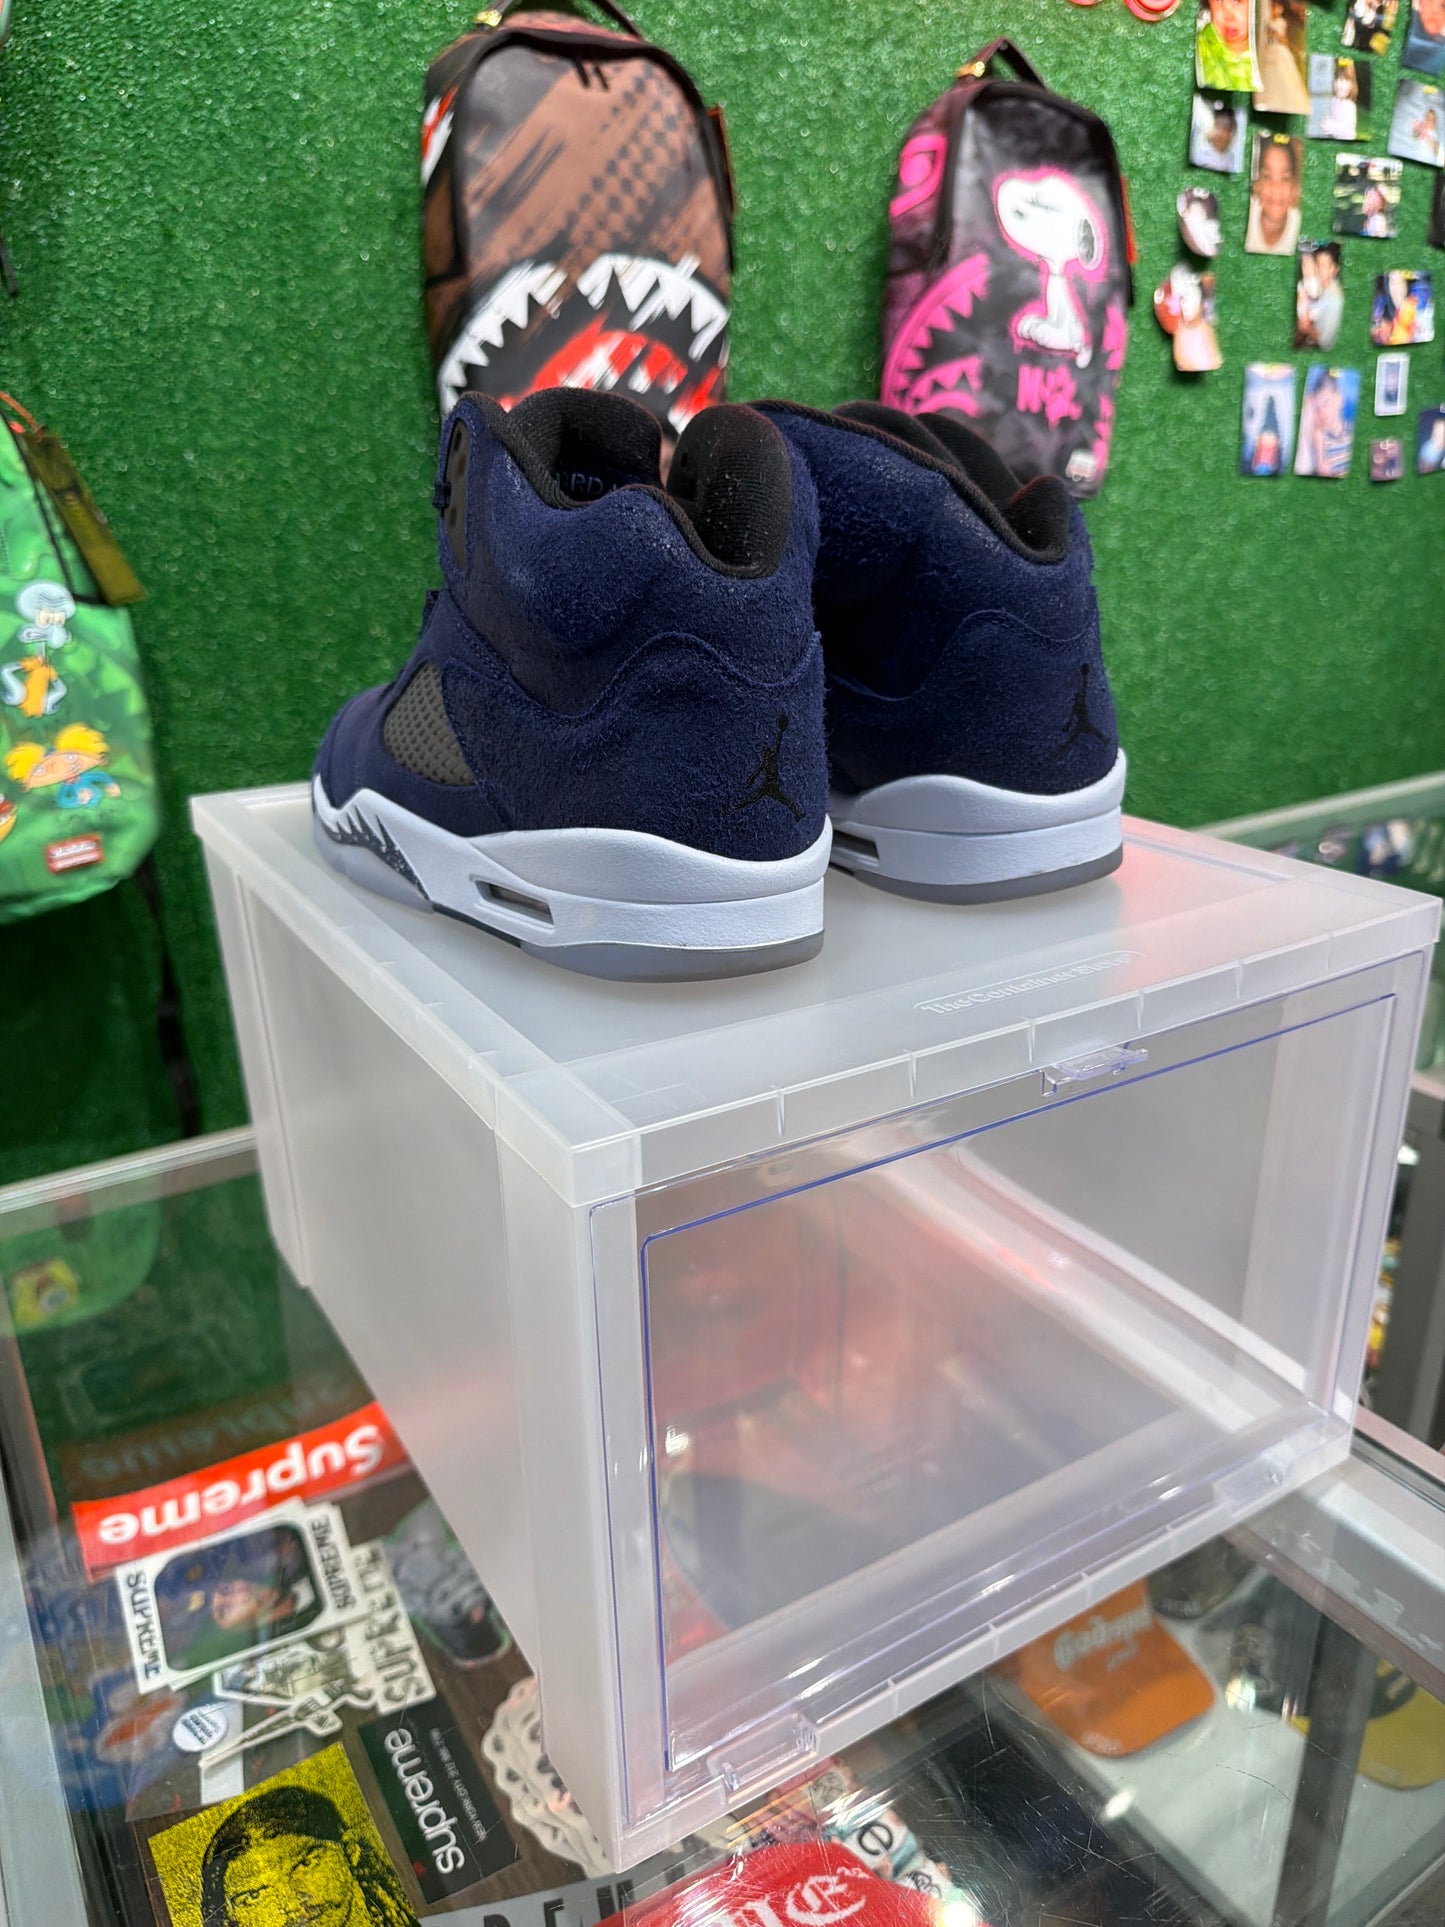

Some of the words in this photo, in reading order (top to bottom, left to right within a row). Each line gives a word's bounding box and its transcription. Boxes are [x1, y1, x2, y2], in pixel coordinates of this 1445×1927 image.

[99, 1423, 384, 1545] Supreme
[127, 1569, 162, 1680] SUPREME
[384, 1728, 465, 1875] supreme
